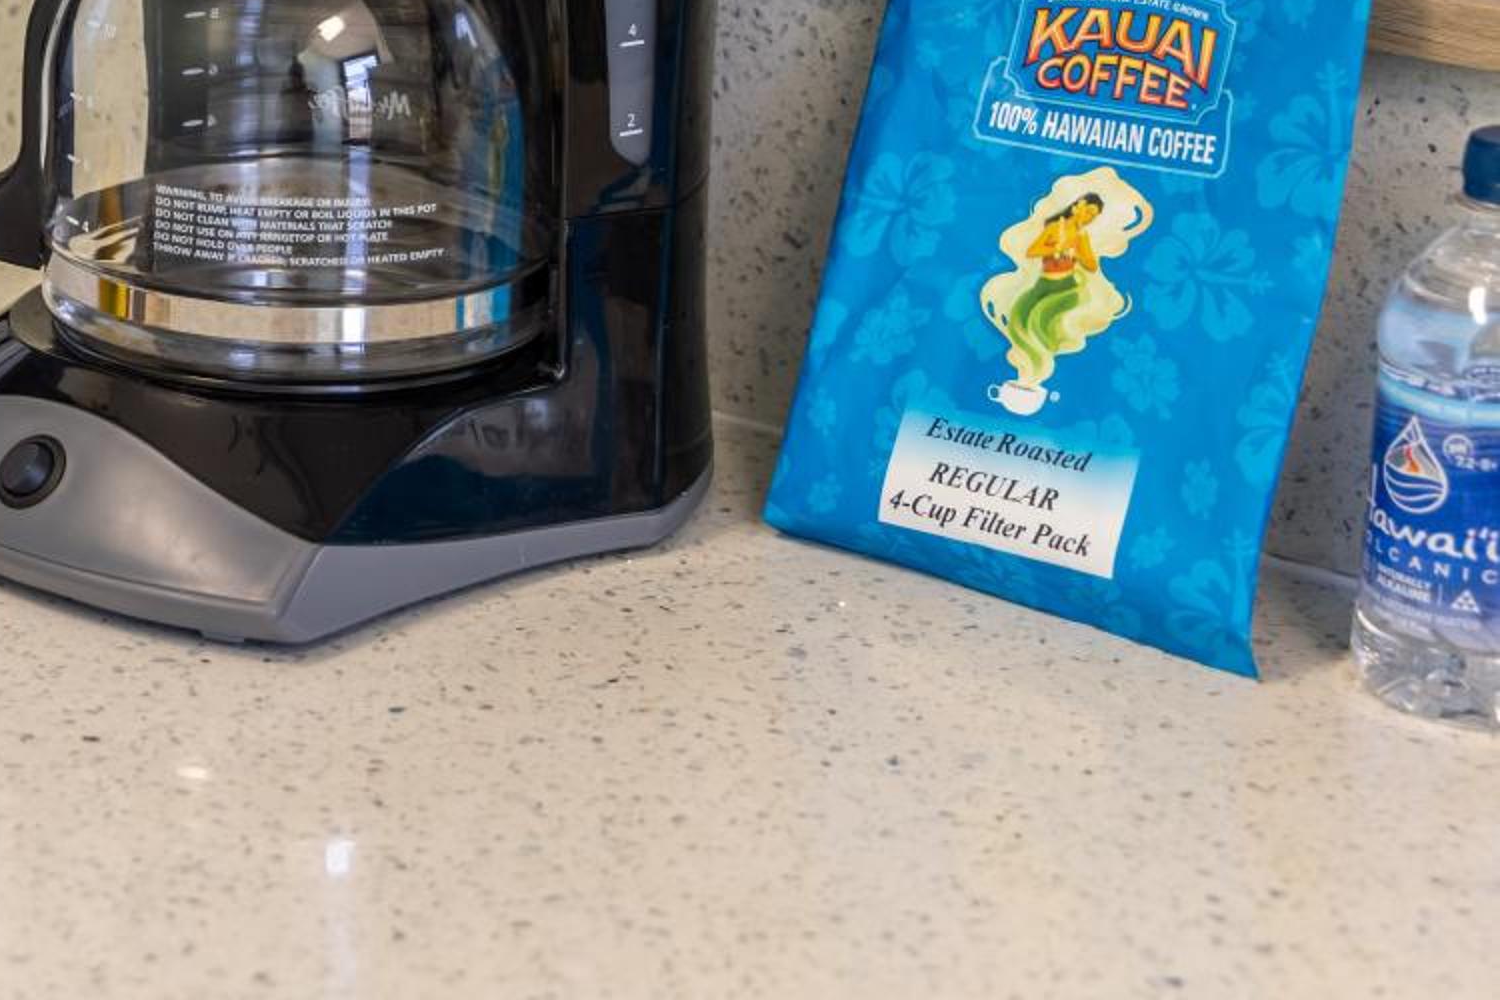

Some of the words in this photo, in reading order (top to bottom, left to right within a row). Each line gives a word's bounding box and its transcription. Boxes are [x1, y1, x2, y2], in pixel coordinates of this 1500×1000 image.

[1171, 2, 1210, 22] GROWN
[628, 23, 638, 36] 4
[1023, 5, 1219, 92] KAUAI
[1036, 52, 1191, 109] COFFEE
[627, 113, 636, 127] 2
[988, 100, 1039, 135] 100%
[1041, 111, 1145, 154] HAWAIIAN
[1147, 126, 1217, 165] COFFEE
[155, 196, 171, 206] DO
[173, 199, 194, 210] NOT
[257, 208, 292, 219] EMPTY
[294, 210, 308, 219] OR
[312, 210, 334, 219] BOIL
[380, 207, 391, 217] IN
[393, 205, 415, 216] THIS
[417, 203, 437, 214] POT
[155, 208, 171, 218] DO
[173, 211, 194, 222] NOT
[197, 215, 229, 227] CLEAN
[260, 221, 315, 231] MATERIALS
[318, 221, 345, 231] THAT
[153, 231, 170, 242] DO
[172, 234, 194, 245] NOT
[196, 238, 224, 249] HOLD
[256, 244, 293, 255] PEOPLE
[155, 219, 170, 230] DO
[172, 222, 194, 234] NOT
[196, 226, 215, 237] USE
[217, 229, 233, 239] ON
[317, 233, 330, 243] OR
[153, 242, 192, 257] THROW
[194, 250, 224, 261] AWAY
[367, 254, 408, 264] HEATED
[410, 248, 445, 260] EMPTY
[925, 415, 993, 450] Estate
[996, 432, 1093, 473] Roasted
[928, 461, 1060, 512] REGULAR
[889, 489, 957, 528] 4-Cup
[963, 506, 1027, 540] Filter
[1032, 523, 1092, 557] Pack
